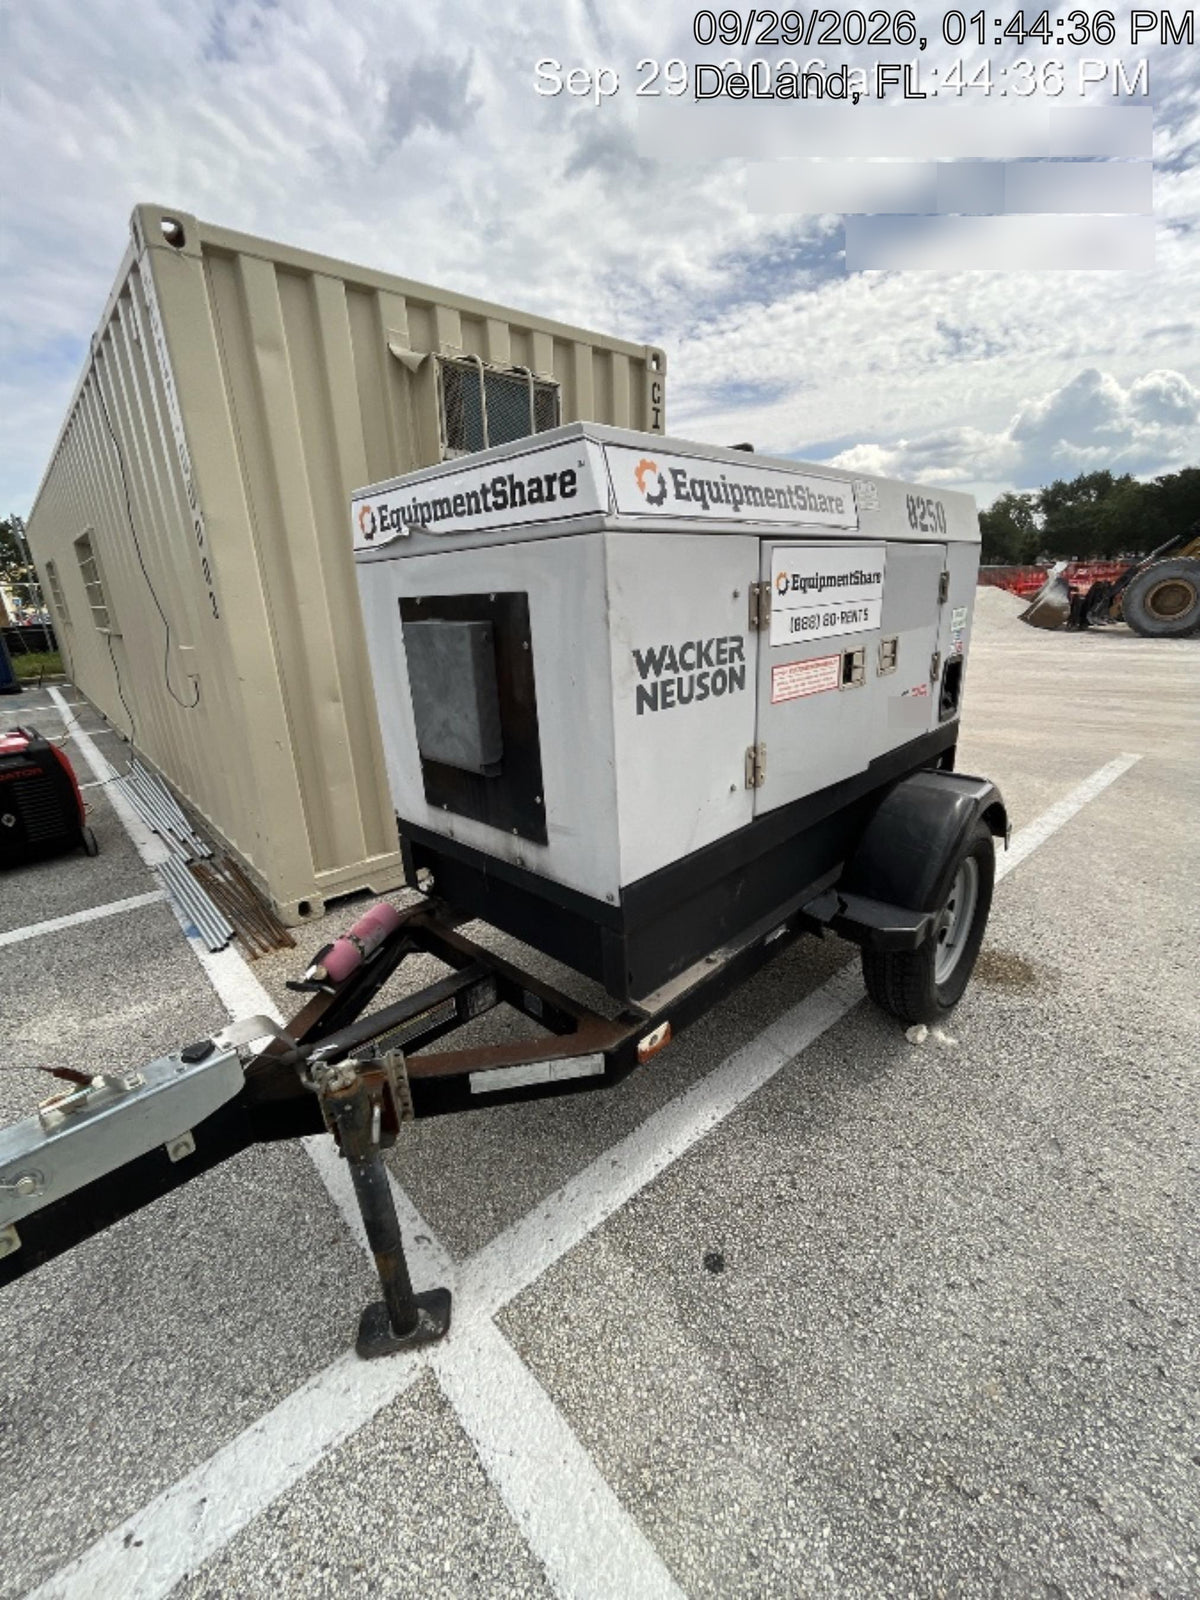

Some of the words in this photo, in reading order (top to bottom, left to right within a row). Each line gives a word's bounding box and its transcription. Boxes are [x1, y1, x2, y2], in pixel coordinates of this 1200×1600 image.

[377, 467, 578, 533] EquipmentShare
[669, 467, 845, 514] EquipmentShare
[790, 570, 882, 594] EquipmentShare
[631, 634, 745, 680] WACKER
[636, 664, 746, 715] NEUSON
